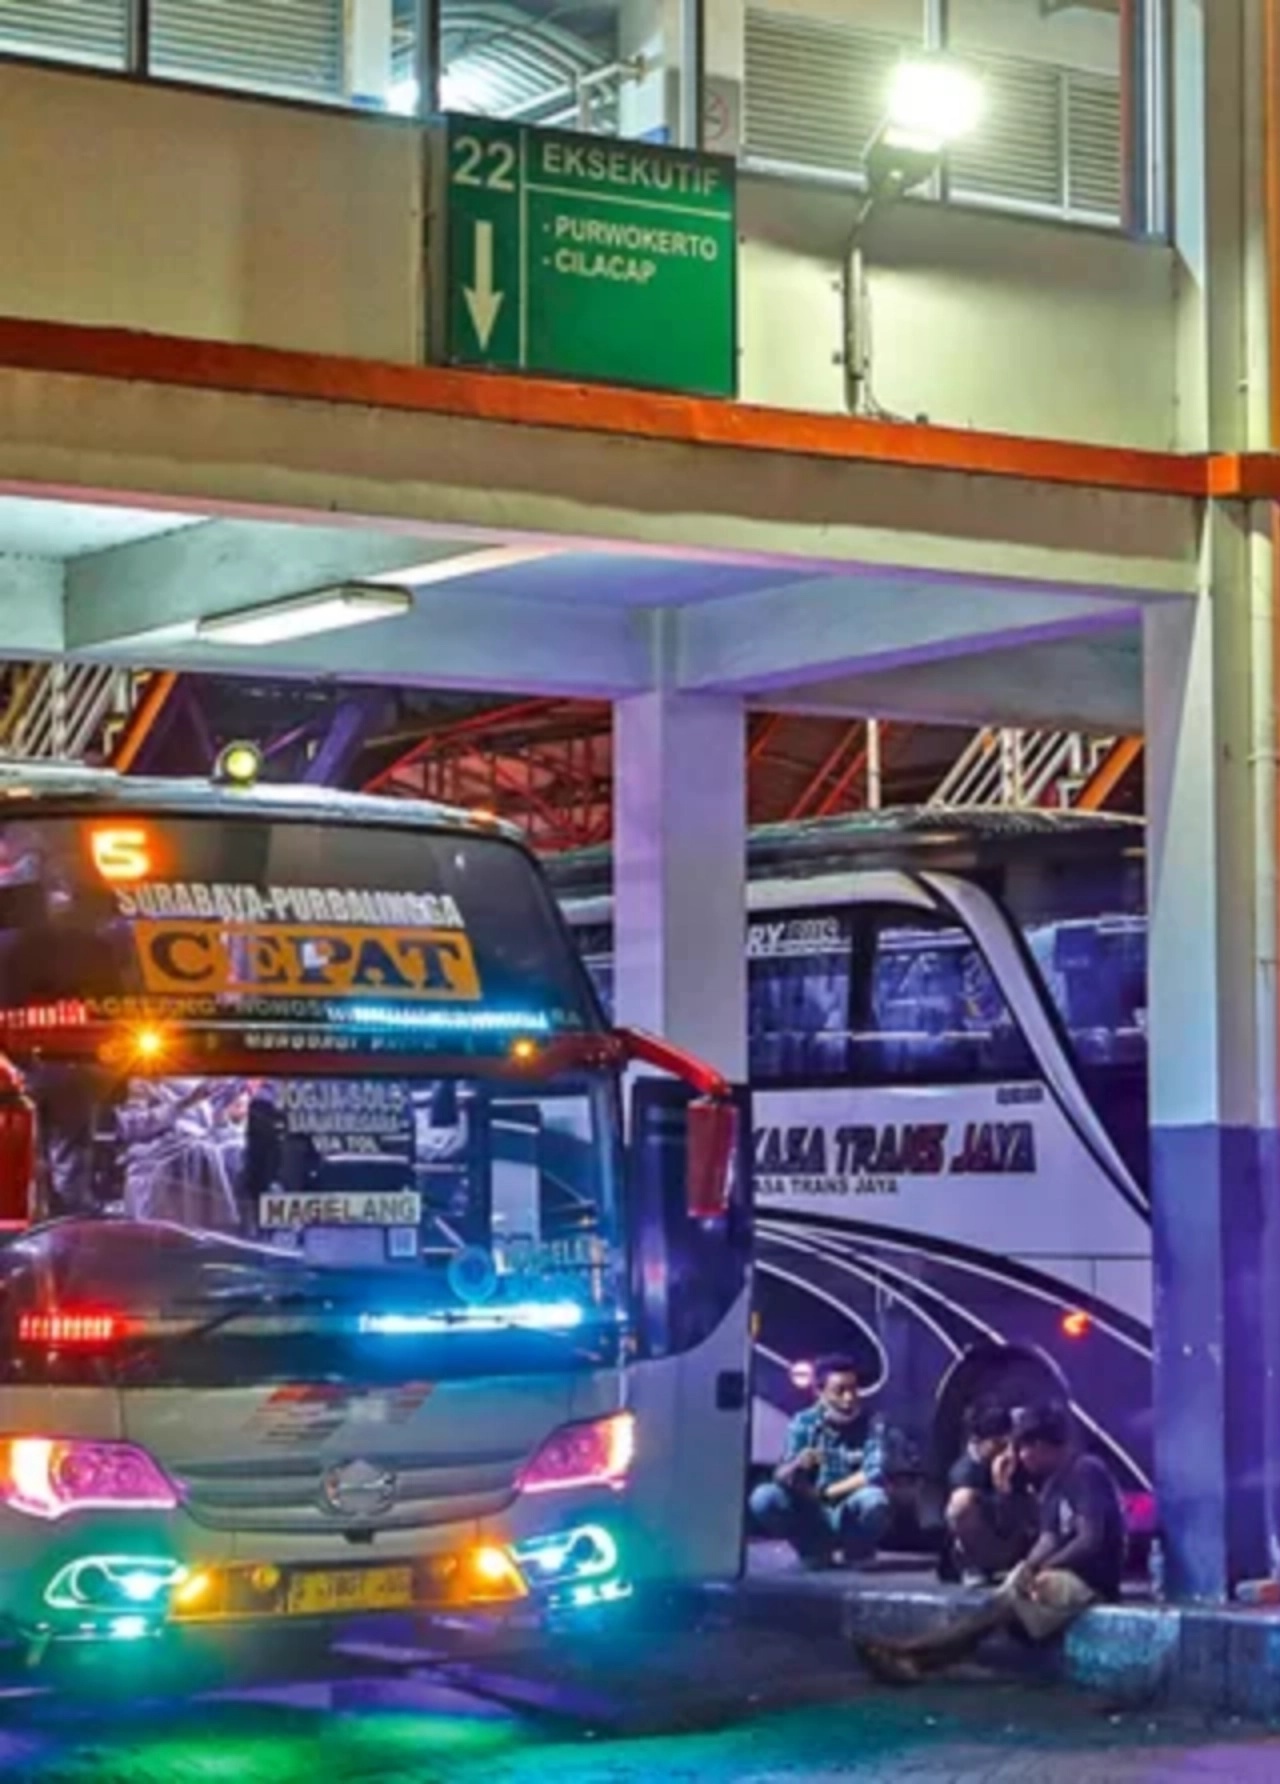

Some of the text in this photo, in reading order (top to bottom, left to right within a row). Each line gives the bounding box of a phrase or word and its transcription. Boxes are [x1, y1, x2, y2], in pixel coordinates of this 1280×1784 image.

[452, 136, 720, 195] 22 EKSEKUTIF
[554, 214, 719, 262] PURWOKERTO
[554, 247, 656, 285] CILACAP
[150, 930, 461, 991] CEPAT
[834, 1123, 948, 1174] TRANS
[948, 1121, 1037, 1173] JAYA
[790, 1176, 849, 1195] TRANS
[854, 1175, 899, 1194] JAYA
[265, 1195, 417, 1225] MAGELANG
